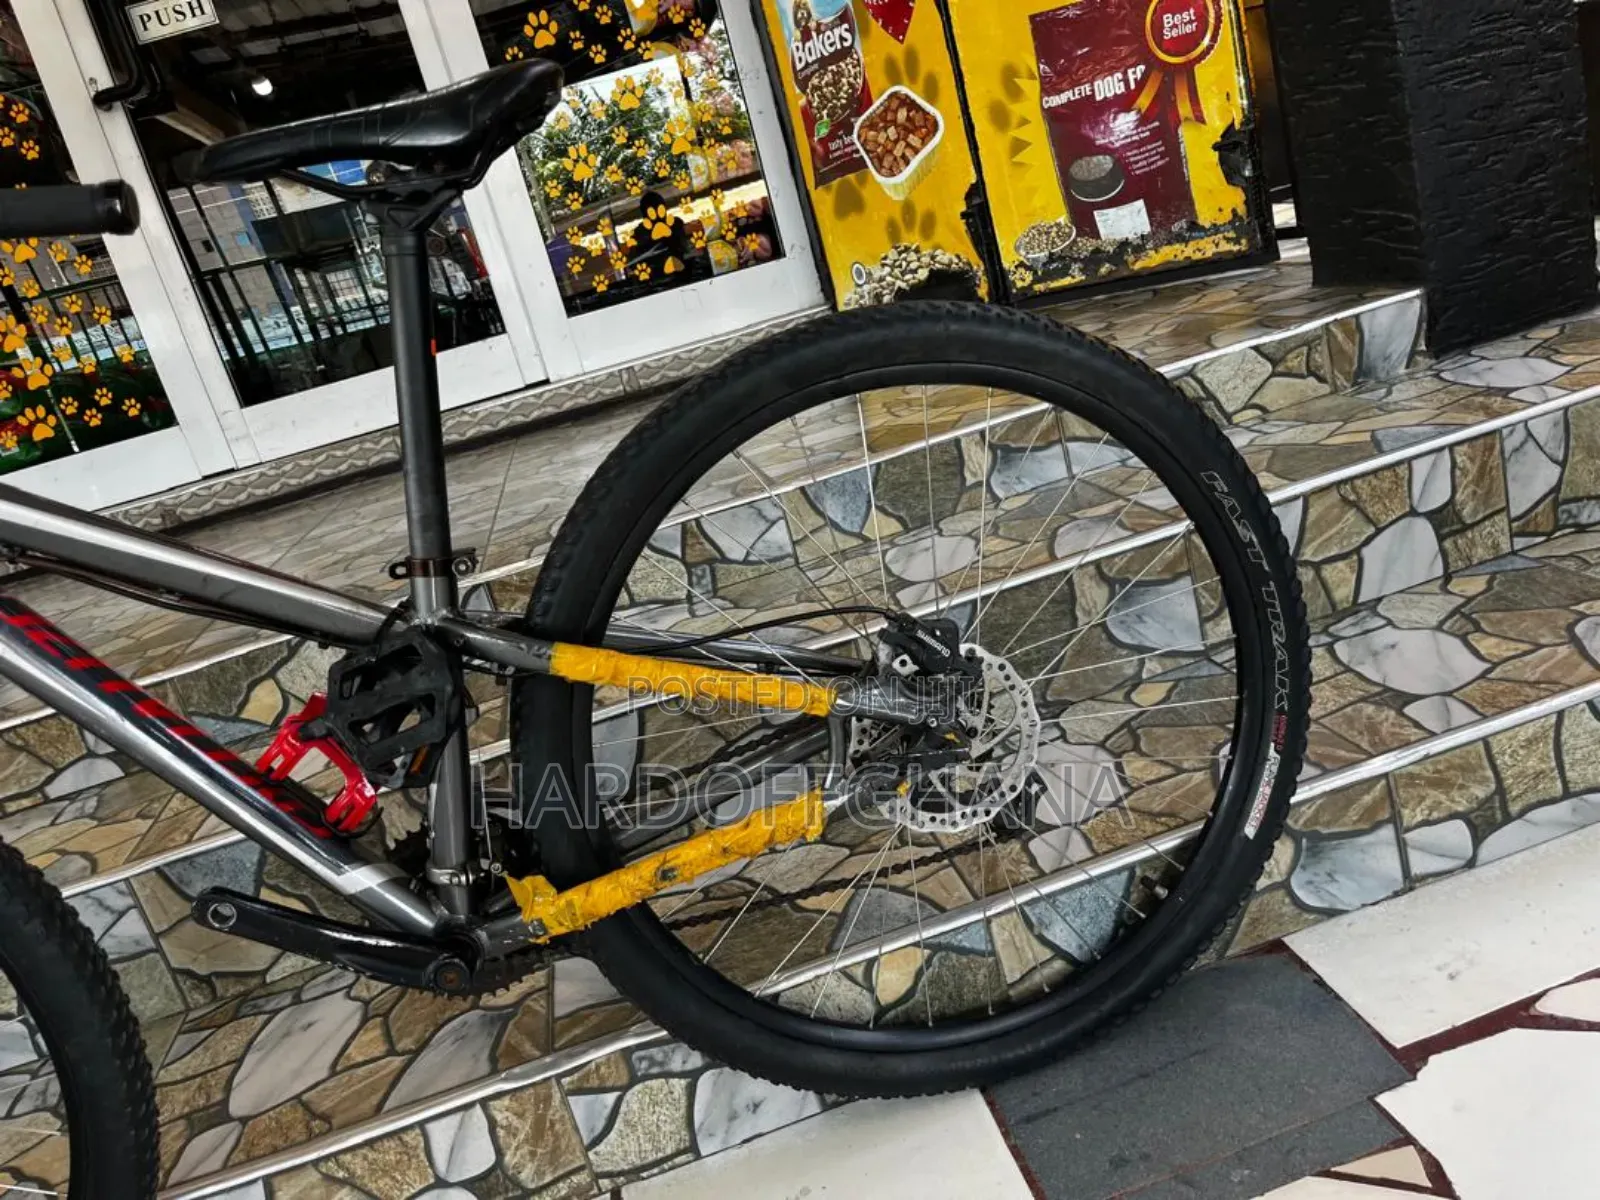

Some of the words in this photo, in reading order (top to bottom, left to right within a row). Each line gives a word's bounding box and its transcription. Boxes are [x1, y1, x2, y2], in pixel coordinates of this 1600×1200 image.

[138, 0, 206, 31] PUSH
[1162, 21, 1198, 40] Seller
[1163, 7, 1196, 28] Best
[792, 23, 853, 71] Bakers
[1042, 83, 1093, 108] COMPLETE
[1094, 72, 1126, 101] DOG
[1201, 470, 1271, 574] FAST
[1260, 580, 1290, 711] TRAK
